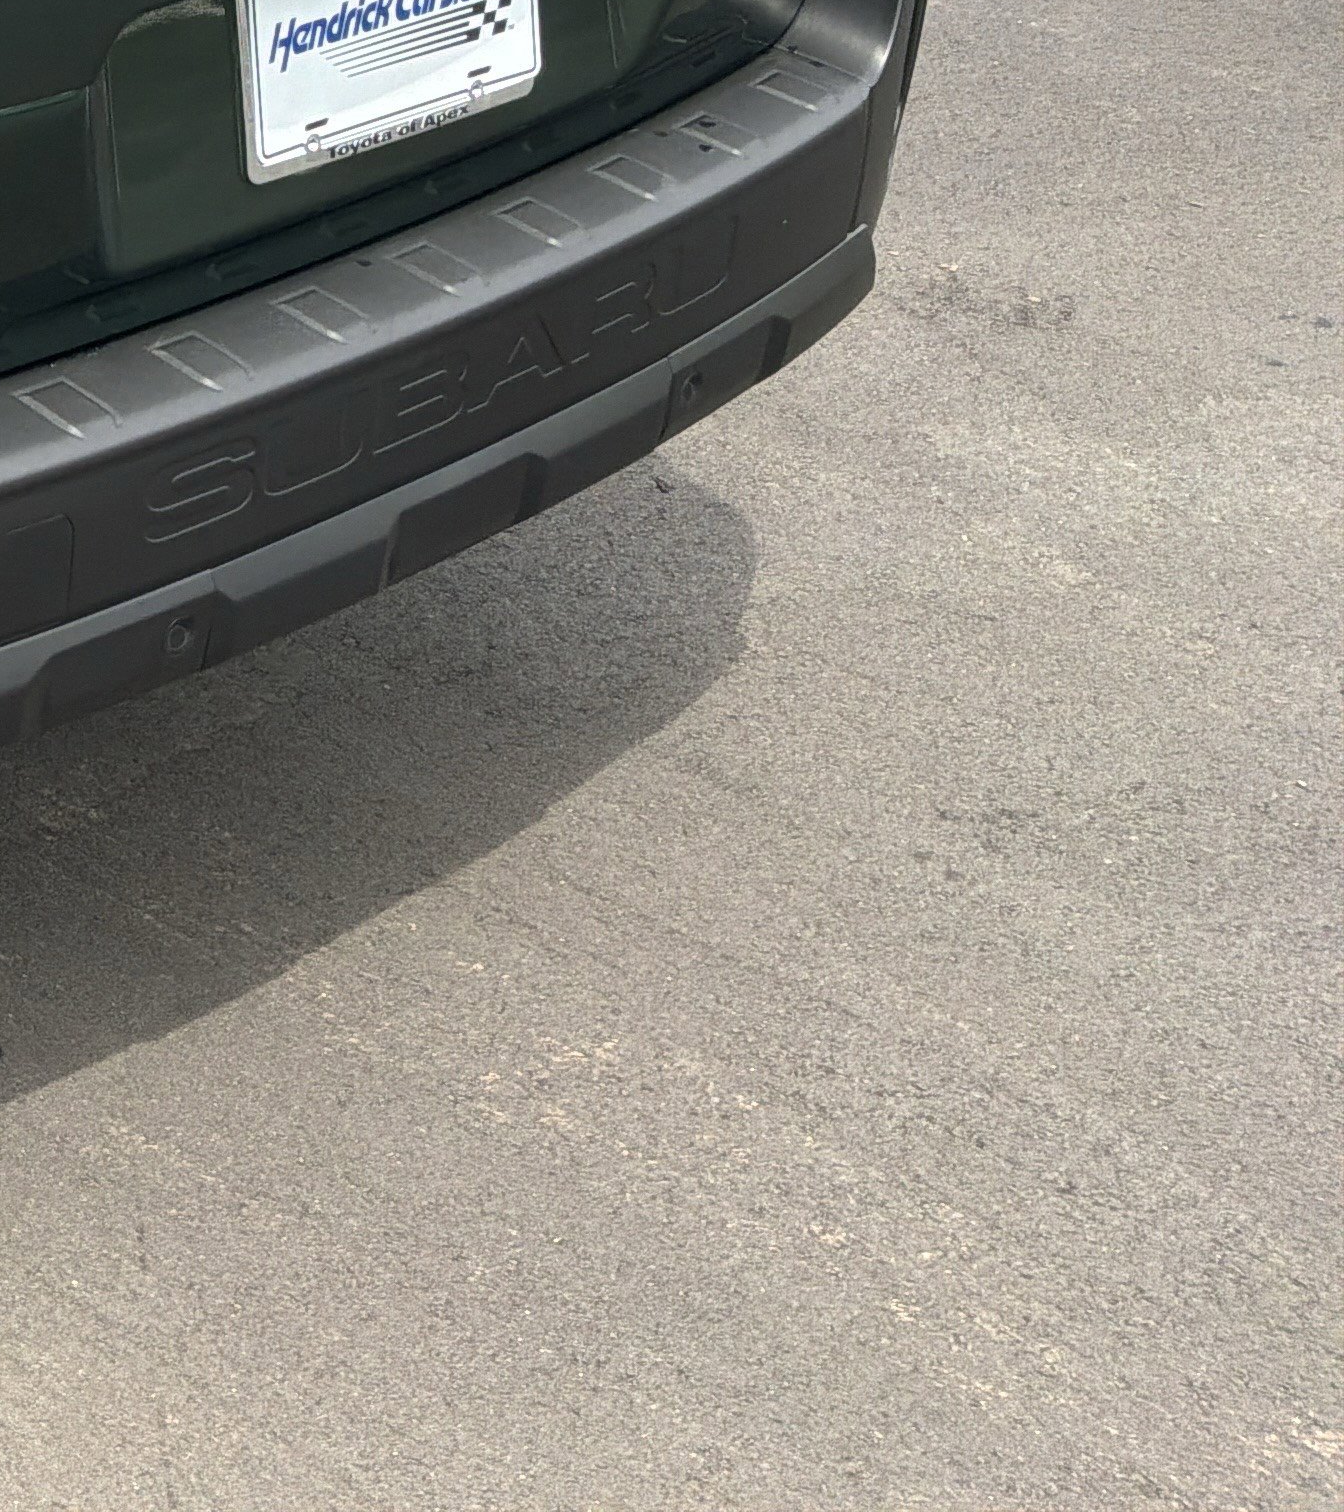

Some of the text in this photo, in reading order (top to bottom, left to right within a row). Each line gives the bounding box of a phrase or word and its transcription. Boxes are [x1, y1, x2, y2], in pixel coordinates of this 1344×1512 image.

[326, 104, 469, 159] Toyota of Apex
[144, 213, 740, 544] SUBARU
